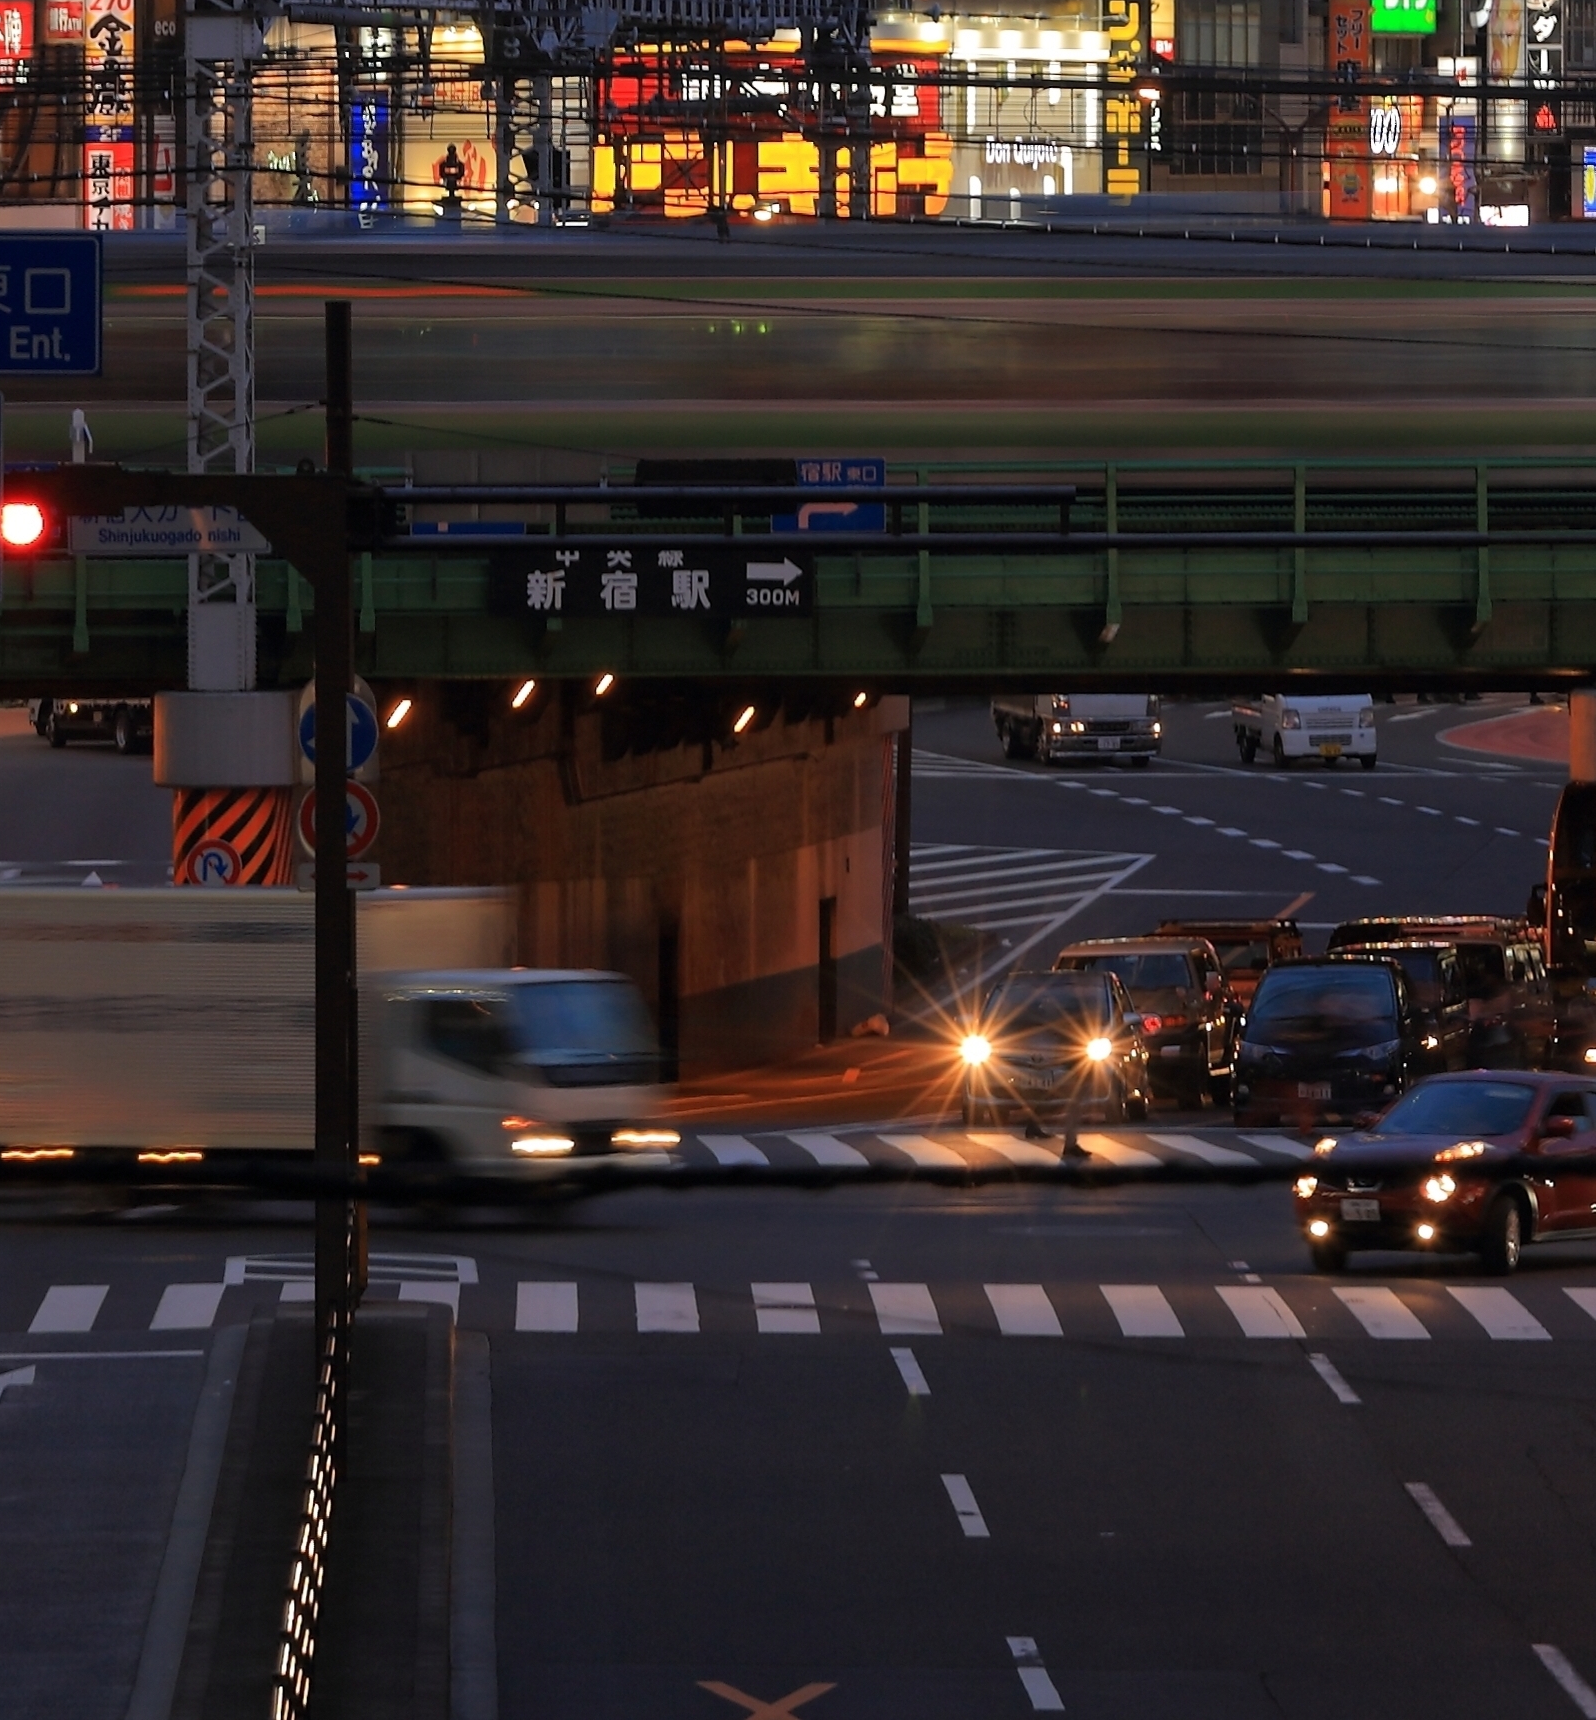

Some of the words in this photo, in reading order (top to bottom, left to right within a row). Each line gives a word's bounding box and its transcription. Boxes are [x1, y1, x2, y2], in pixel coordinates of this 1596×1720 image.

[154, 21, 176, 36] eco
[986, 135, 1010, 164] Don
[9, 327, 71, 361] Ent.
[527, 569, 710, 609] 新宿駅
[746, 587, 800, 606] 300M
